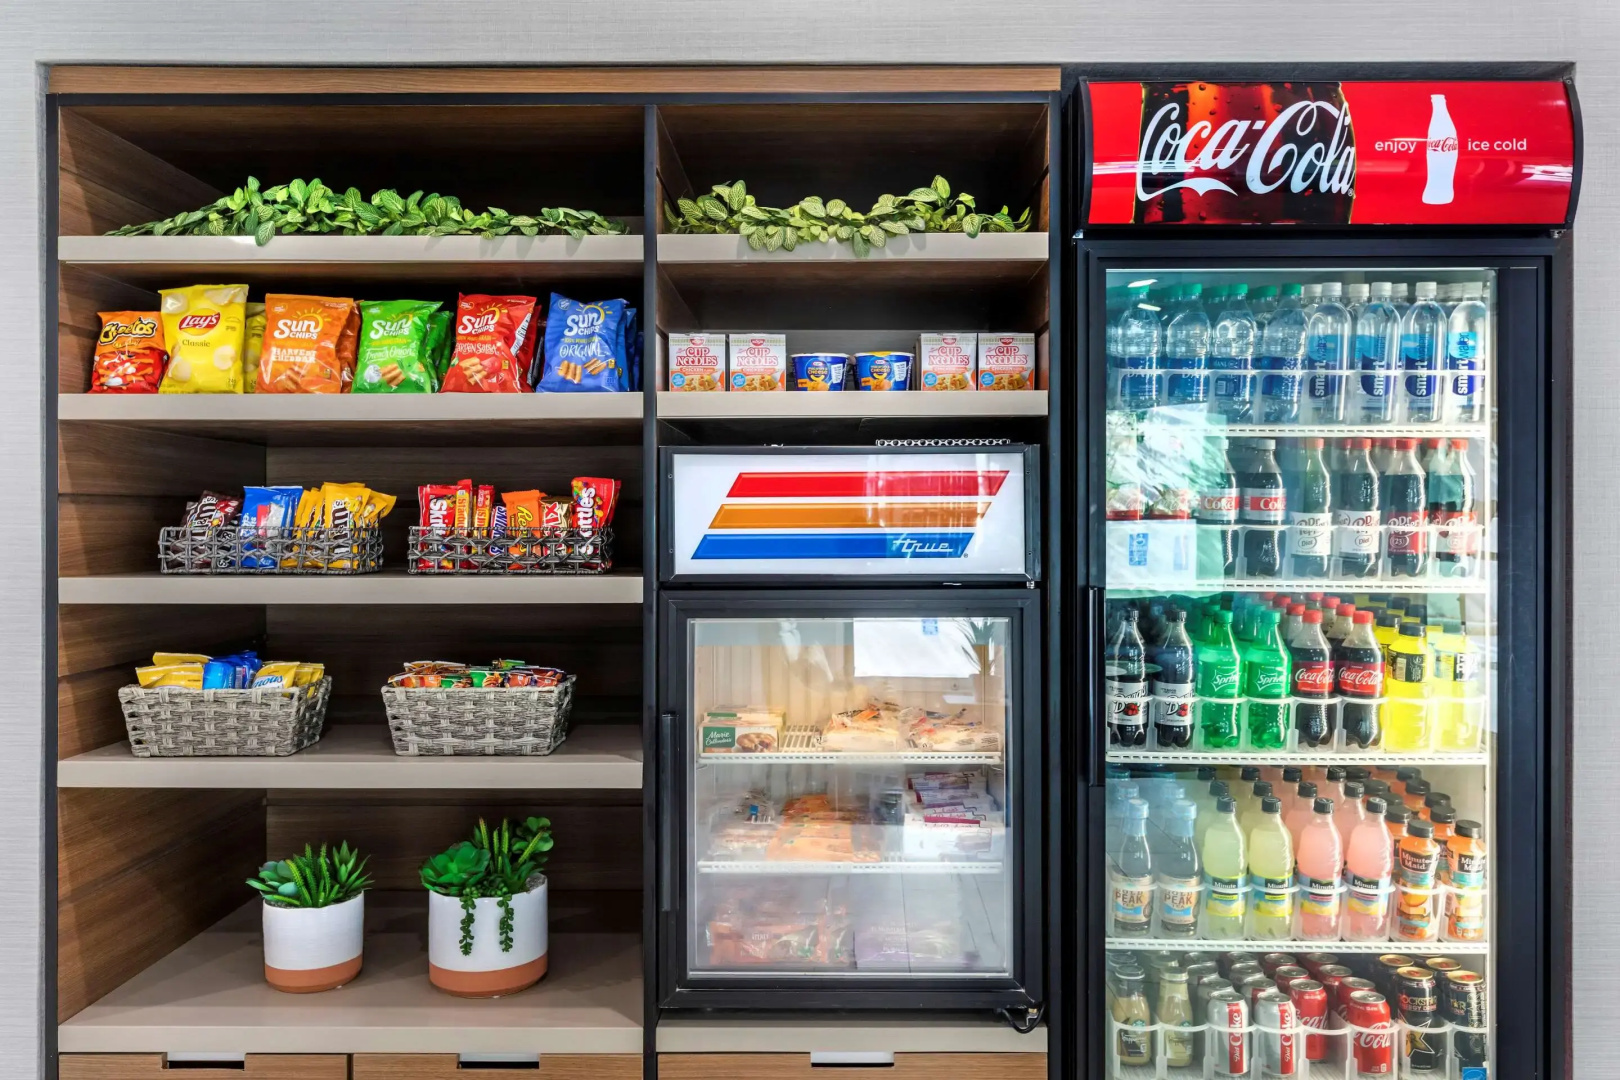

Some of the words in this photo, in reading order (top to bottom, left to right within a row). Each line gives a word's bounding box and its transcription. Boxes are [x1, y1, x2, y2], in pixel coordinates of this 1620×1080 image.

[1137, 100, 1355, 201] Coca-Cola
[1375, 140, 1416, 153] enjoy
[1468, 139, 1489, 151] ice
[1494, 139, 1527, 151] cold
[1428, 137, 1458, 152] ca-Cola
[180, 312, 219, 328] Lay's
[458, 312, 498, 335] Sun
[564, 312, 602, 336] Sun
[100, 317, 156, 344] Cheetos
[274, 318, 317, 339] Sun
[370, 318, 409, 339] Sun
[383, 328, 410, 336] CHIPS
[472, 325, 495, 335] CHIPS
[578, 327, 600, 336] CHIPS
[289, 331, 318, 340] CHIPS
[182, 339, 210, 348] Classic
[560, 344, 606, 358] ORIGINAL
[686, 347, 710, 357] CUP
[746, 347, 770, 357] CUP
[938, 346, 962, 356] CUP
[995, 346, 1019, 356] CUP
[676, 356, 718, 366] NOODLES
[737, 356, 778, 366] NOODLES
[928, 355, 970, 366] NOODLES
[985, 355, 1028, 366] NOODLES
[1204, 498, 1234, 510] Coke
[429, 499, 447, 536] Skitt
[456, 497, 468, 537] Starbu
[577, 487, 596, 555] Skttles
[490, 505, 507, 555] SNICKS
[892, 533, 954, 558] true
[1301, 539, 1314, 547] Diet
[1358, 537, 1370, 545] Diet
[1295, 667, 1335, 685] Coca-Cola
[1338, 667, 1381, 686] Coca-Cola
[708, 731, 730, 739] Marie
[1403, 852, 1432, 865] Minute
[1404, 860, 1427, 870] Maid
[1214, 881, 1236, 889] Minute
[1354, 880, 1377, 889] Minute
[1115, 890, 1143, 904] PEAK
[1164, 893, 1193, 905] PEAK
